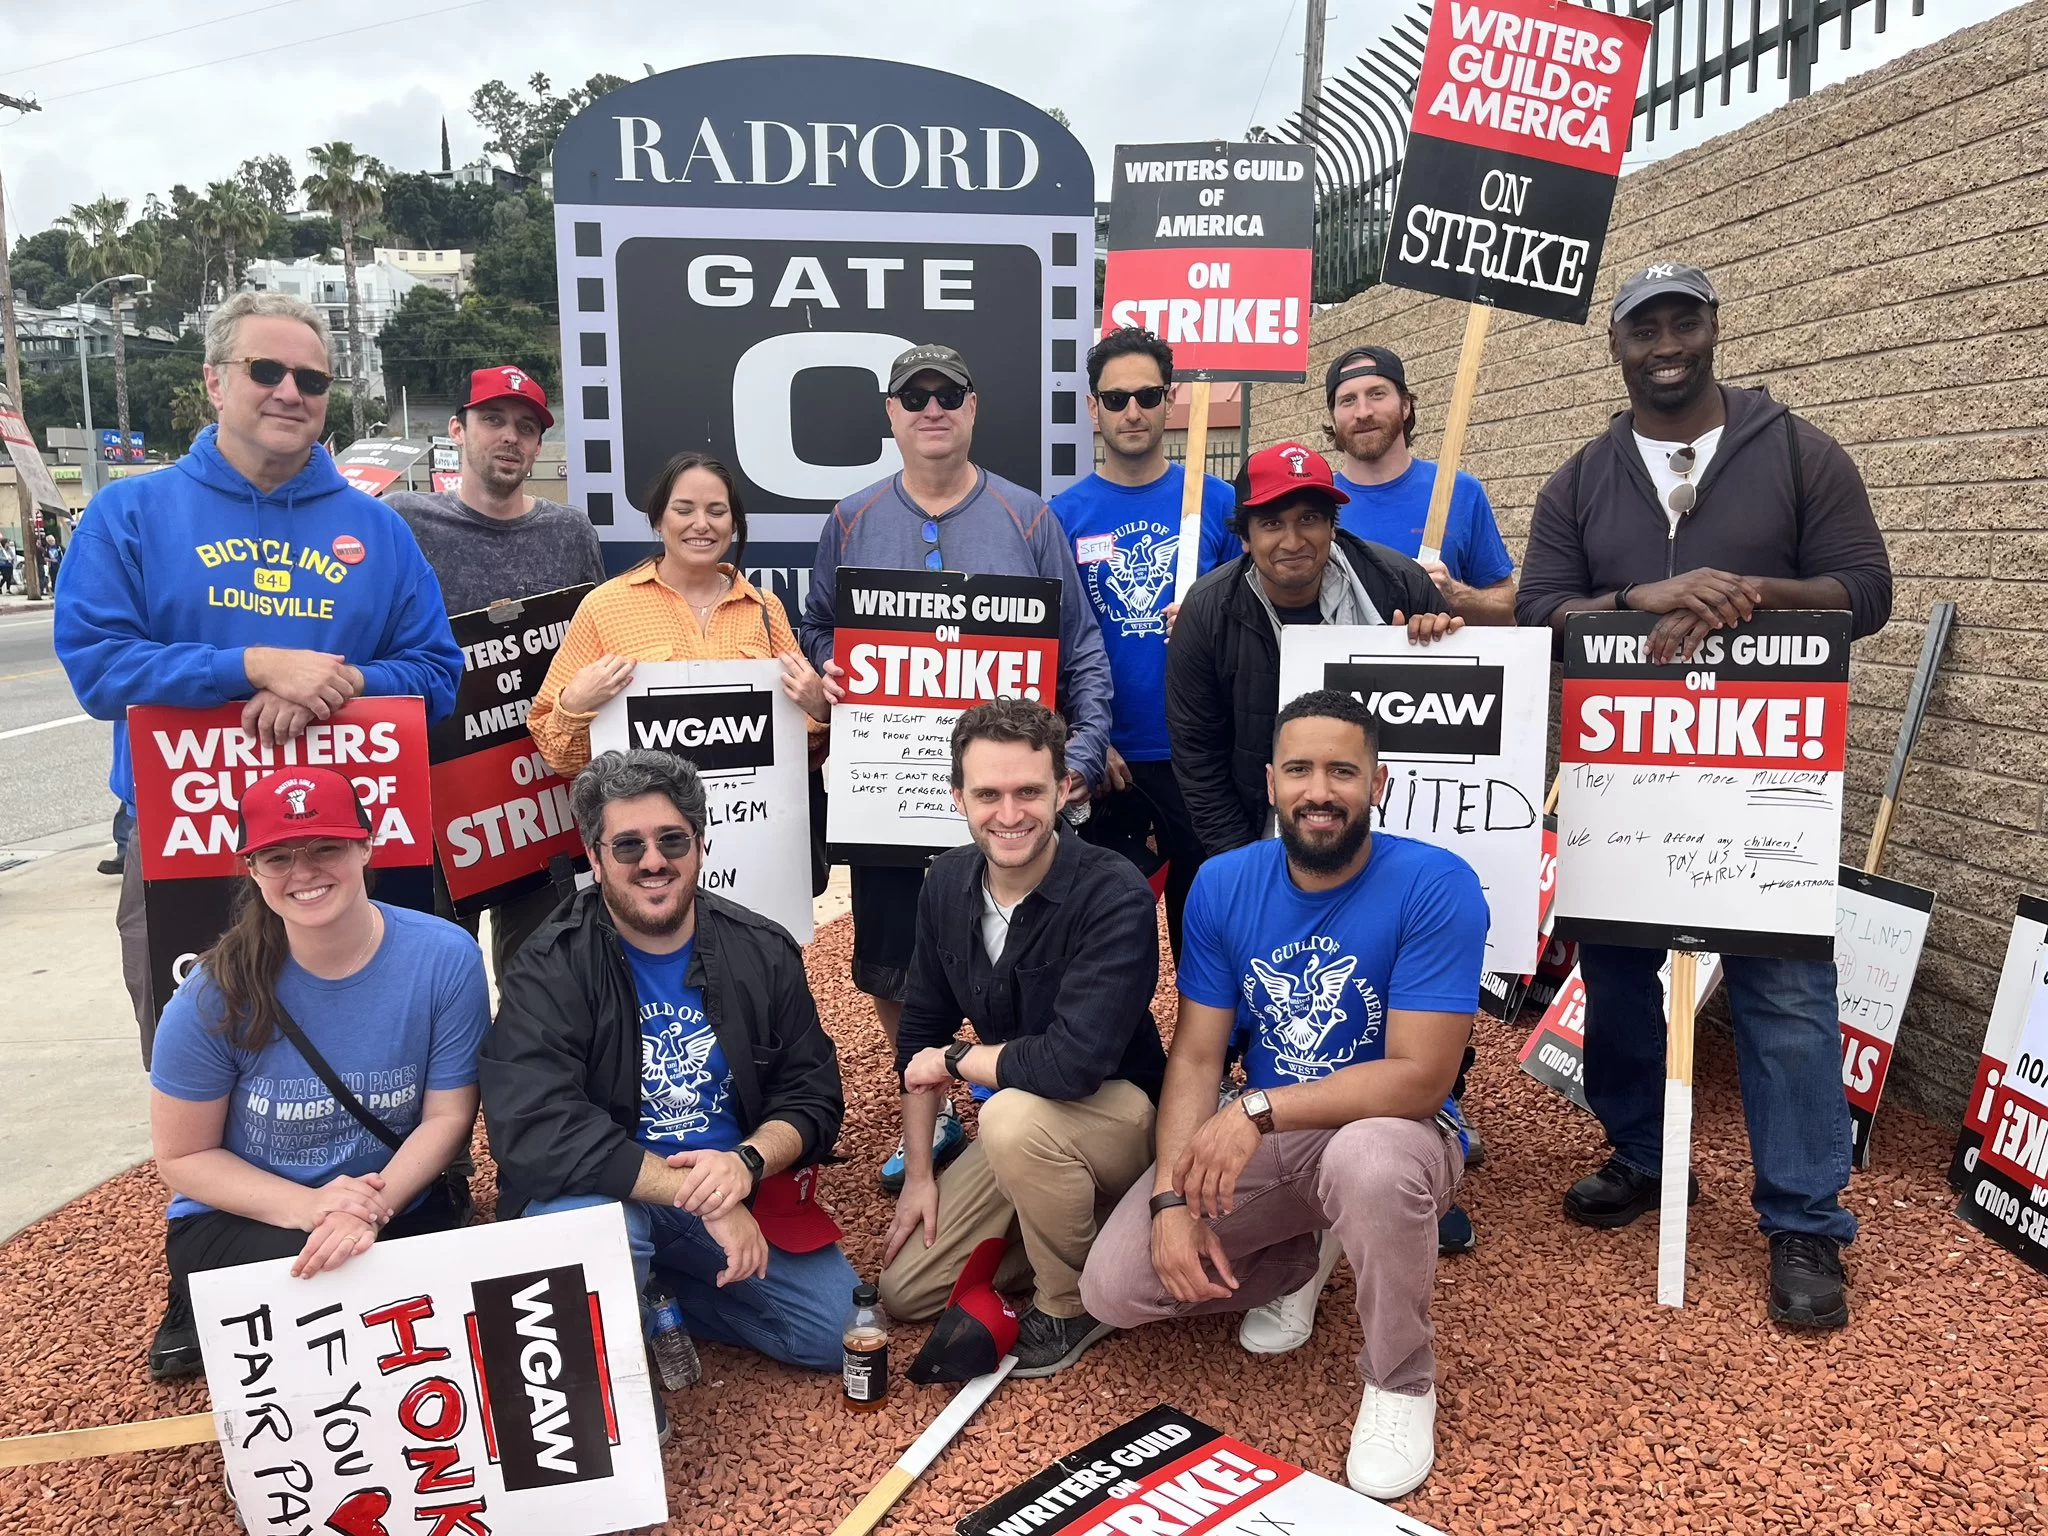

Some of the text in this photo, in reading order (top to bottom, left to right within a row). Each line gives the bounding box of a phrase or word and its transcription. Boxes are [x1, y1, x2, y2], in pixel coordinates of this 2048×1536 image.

[1449, 0, 1623, 75] WRITERS
[1448, 44, 1612, 112] GUILD OF
[1427, 82, 1611, 154] AMERICA
[612, 116, 1040, 192] RADFORD
[1125, 158, 1304, 184] WRITERS GUILD
[1199, 188, 1225, 208] OF
[1480, 169, 1532, 216] ON
[1155, 214, 1265, 239] AMERICA
[1398, 203, 1590, 297] STRIKE
[687, 254, 975, 310] GATE
[1188, 262, 1230, 290] ON
[1111, 297, 1299, 346] STRIKE!
[732, 331, 918, 501] C
[1151, 522, 1170, 536] OF
[196, 537, 348, 584] BICYCLING
[1080, 541, 1111, 555] SETH
[257, 573, 288, 588] B4L
[1088, 560, 1107, 614] WRITER
[208, 585, 335, 620] LOUISVILLE
[851, 588, 1046, 624] WRITERS GUILD
[935, 625, 960, 643] ON
[1131, 622, 1153, 630] WEST
[464, 619, 571, 673] TERS GUI
[1582, 635, 1830, 666] WRIERS GUILD
[496, 669, 523, 694] OF
[848, 643, 1042, 703] STRIKE!
[1685, 671, 1716, 691] ON
[464, 696, 535, 741] AMER
[633, 714, 768, 749] WGAW
[851, 711, 957, 725] THE NIGHT AGE
[852, 729, 870, 738] THE
[883, 731, 911, 740] PHONE
[1579, 694, 1826, 760] STRIKE!
[152, 721, 400, 770] WRITERS
[902, 747, 943, 757] A FAIR
[348, 775, 397, 806] OF
[852, 785, 887, 793] LATEST
[932, 773, 952, 782] RES
[1573, 763, 1615, 796] They
[1633, 771, 1680, 785] want
[706, 800, 768, 826] LISM
[898, 800, 907, 812] A
[915, 802, 945, 811] FAIR
[446, 782, 578, 868] STRI
[1691, 860, 1758, 888] FAIRLY!
[1709, 850, 1729, 864] US
[702, 868, 736, 888] ION
[678, 1006, 704, 1025] OF
[1352, 977, 1382, 1046] AMERICA
[1840, 988, 1894, 1031] CLEAR
[1287, 1063, 1319, 1076] WEST
[1538, 1043, 1577, 1077] GUILD
[250, 1076, 274, 1099] NO
[369, 1064, 417, 1091] PAGES
[247, 1092, 270, 1116] NO
[276, 1097, 335, 1121] WAGES
[369, 1084, 416, 1109] PAGES
[273, 1117, 334, 1135] WAGES
[269, 1148, 328, 1166] WAGES
[331, 1142, 356, 1165] NO
[1975, 1179, 2020, 1226] GUILD
[220, 1303, 293, 1450] FAIR
[296, 1302, 374, 1477] IF YOU
[511, 1277, 579, 1475] WGAW
[360, 1294, 494, 1536] HONK
[989, 1423, 1192, 1536] WRITERS GUILD
[1073, 1449, 1279, 1536] RIKE!
[1107, 1478, 1144, 1500] ON
